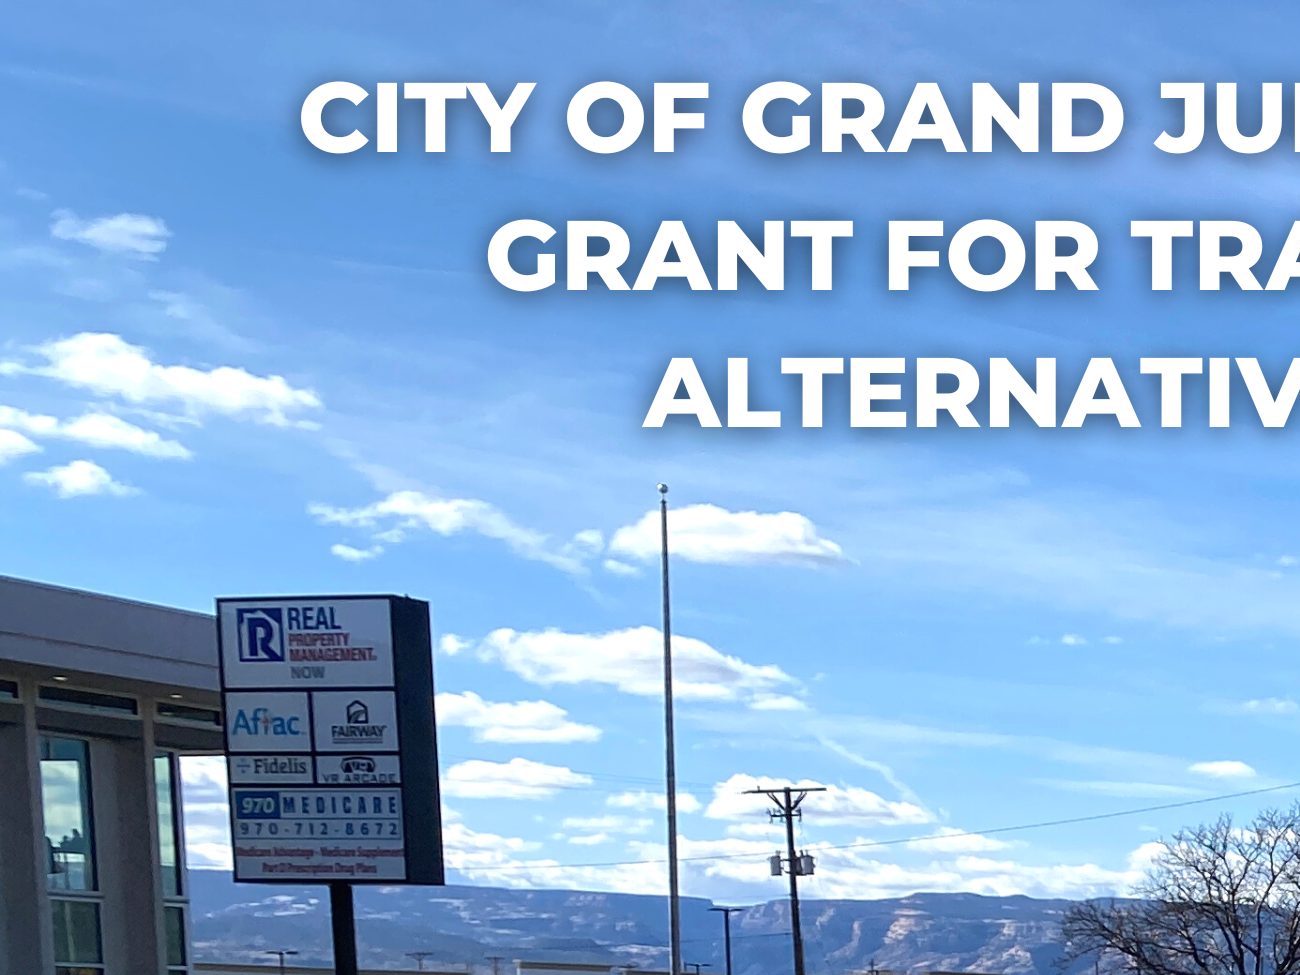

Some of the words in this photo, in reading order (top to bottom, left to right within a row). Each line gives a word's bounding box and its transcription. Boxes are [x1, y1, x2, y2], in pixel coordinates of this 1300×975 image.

[287, 607, 342, 630] REAL
[288, 632, 350, 647] PROPERTY
[290, 666, 325, 679] NOW
[331, 725, 386, 737] FAIRWAY
[253, 758, 307, 774] Fidelis
[322, 773, 340, 783] VR
[344, 773, 397, 783] ARCADE
[241, 797, 276, 814] 970
[283, 797, 397, 814] MEDICARE
[240, 822, 398, 836] 970-712-8672
